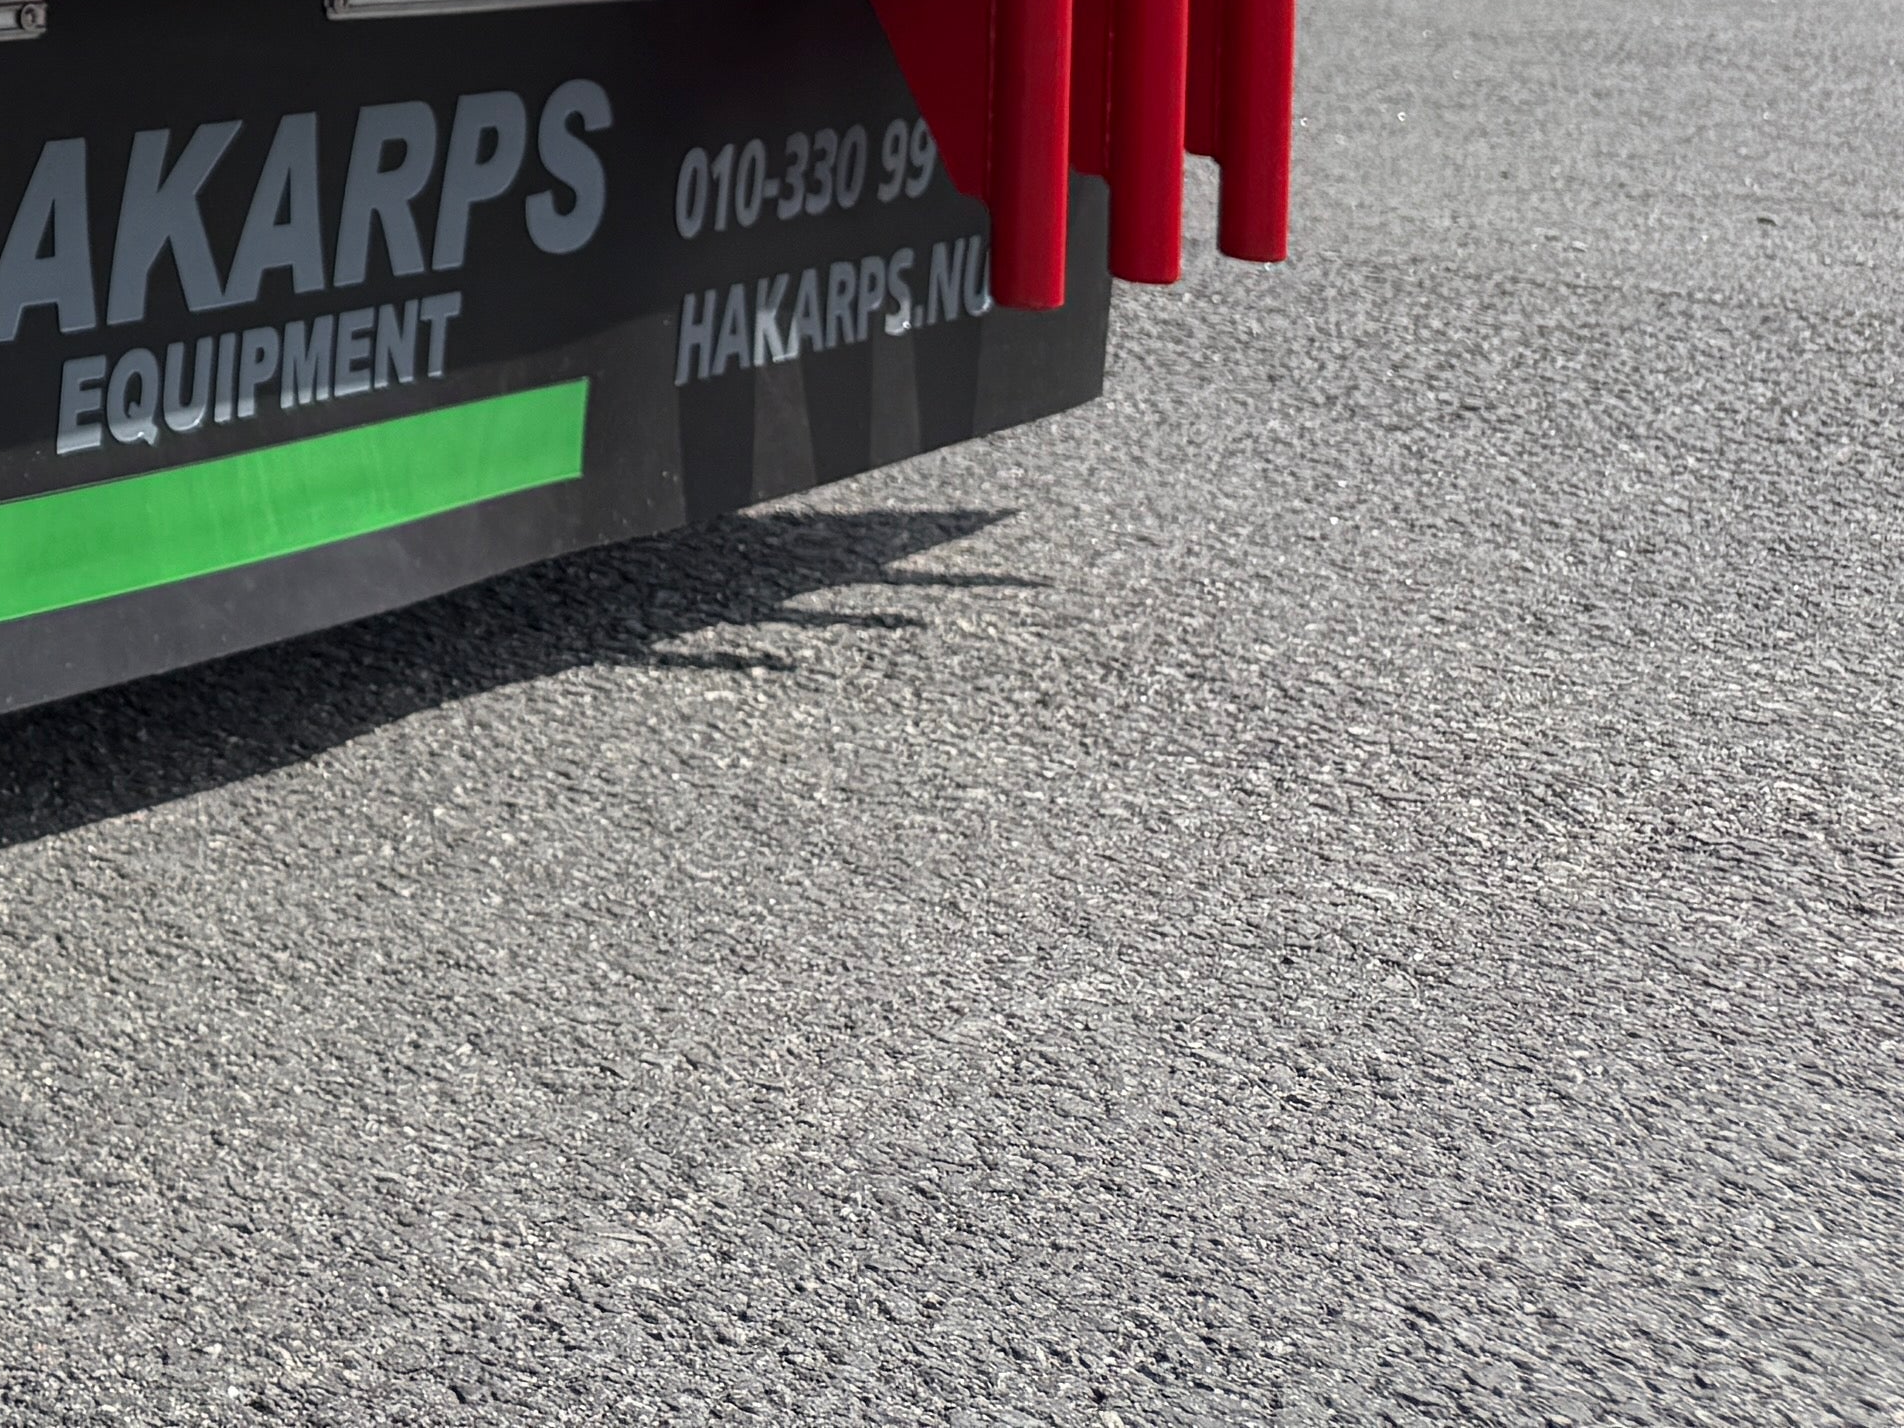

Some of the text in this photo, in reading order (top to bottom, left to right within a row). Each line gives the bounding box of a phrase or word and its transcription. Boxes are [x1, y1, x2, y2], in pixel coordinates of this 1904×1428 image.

[676, 123, 868, 239] 010-330
[56, 291, 462, 455] EQUIPMENT
[674, 235, 991, 386] HAKARPS.NU
